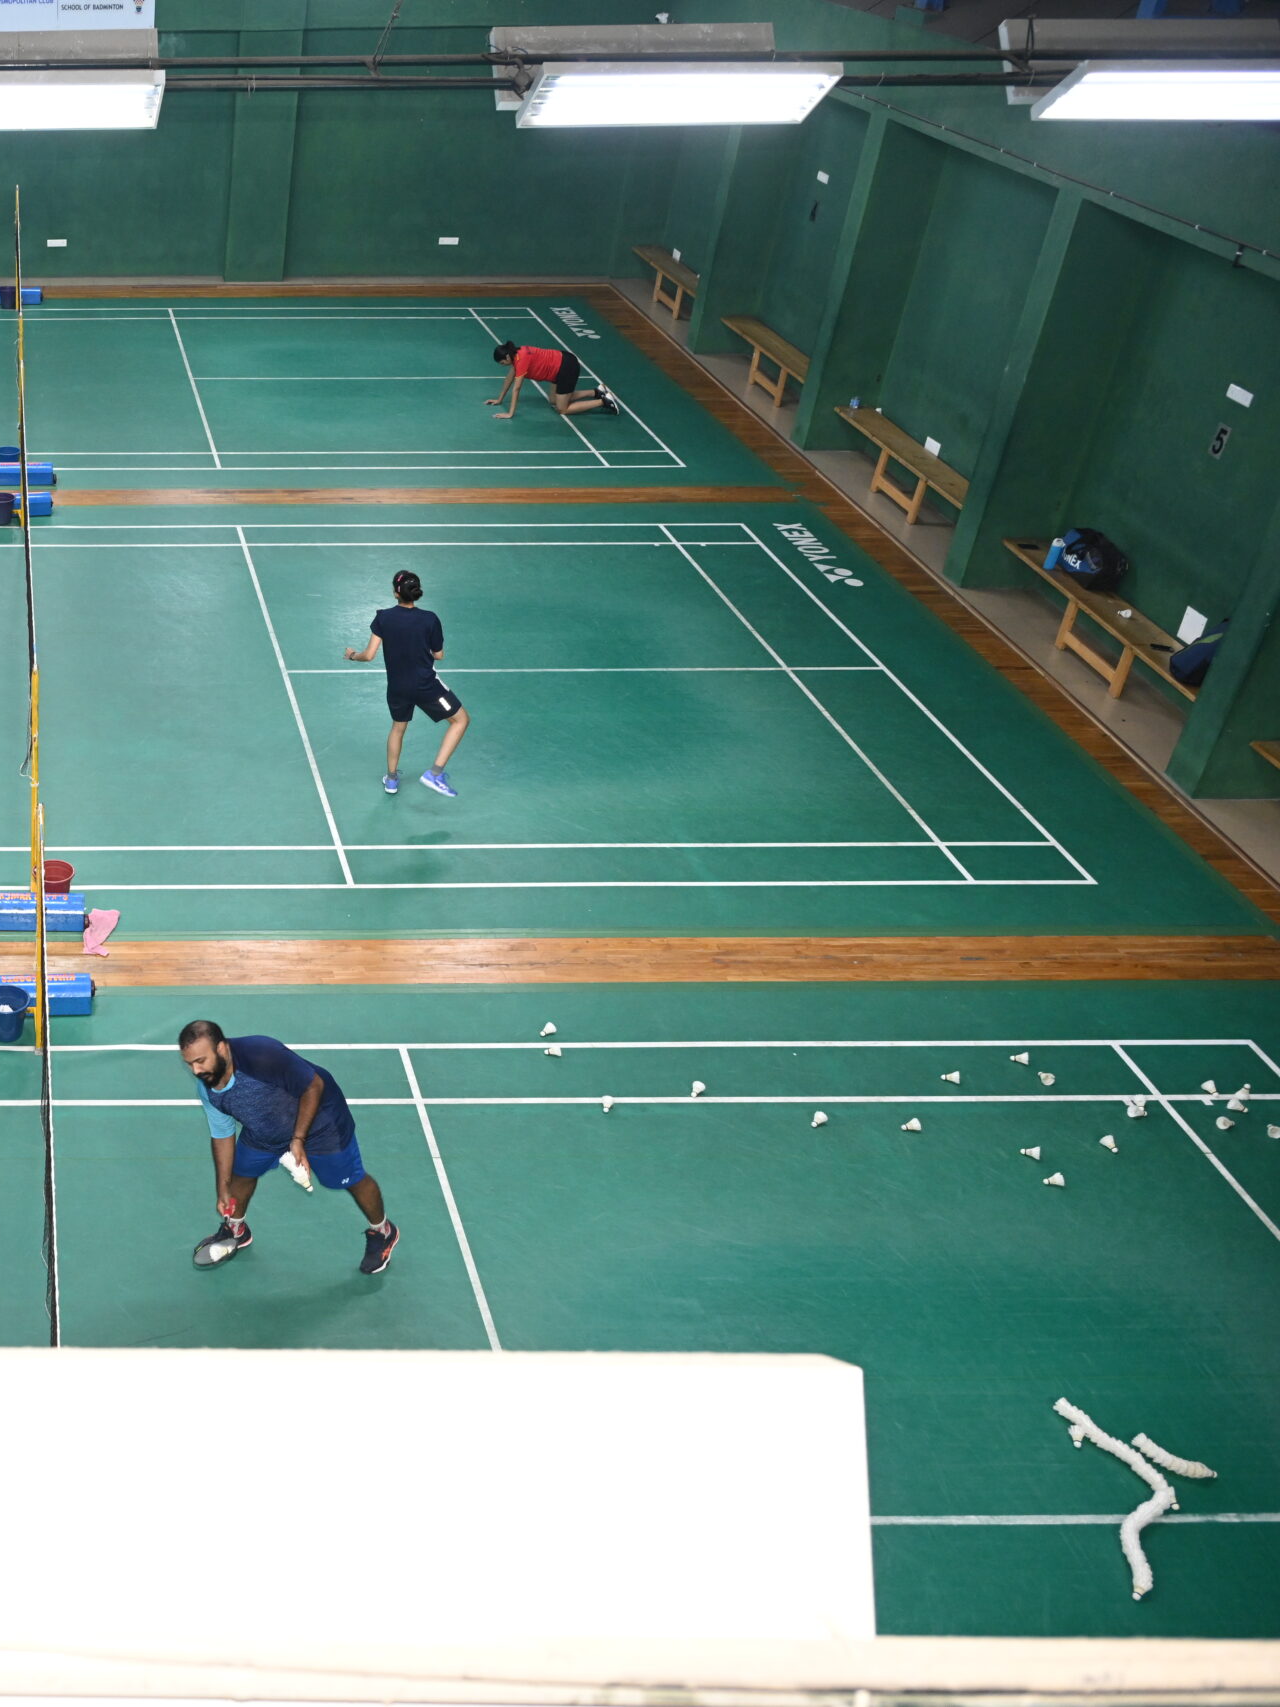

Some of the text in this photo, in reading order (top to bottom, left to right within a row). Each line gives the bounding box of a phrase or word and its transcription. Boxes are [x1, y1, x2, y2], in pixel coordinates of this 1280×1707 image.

[549, 306, 588, 327] YONEX
[1212, 428, 1228, 454] 5
[772, 522, 837, 562] YONEX
